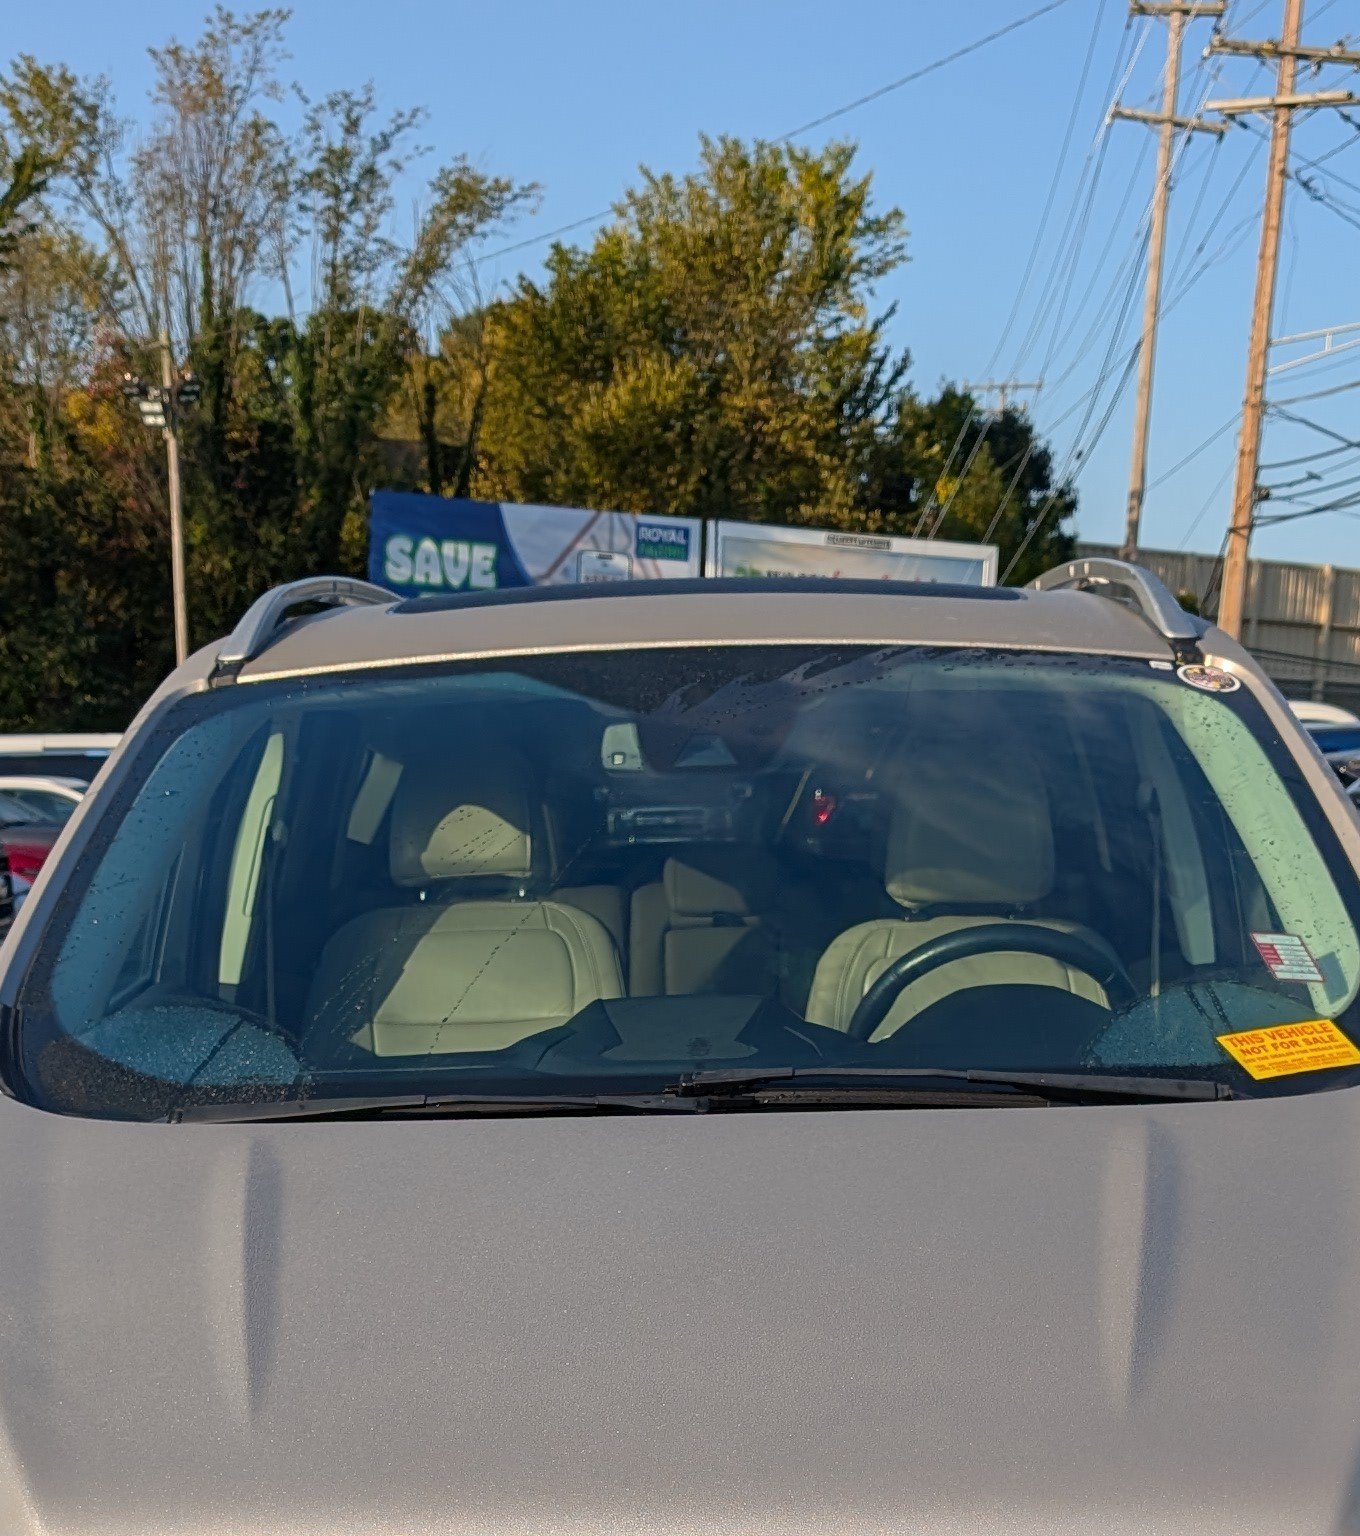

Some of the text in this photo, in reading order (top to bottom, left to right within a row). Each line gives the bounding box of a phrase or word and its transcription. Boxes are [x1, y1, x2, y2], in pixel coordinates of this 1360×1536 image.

[638, 526, 687, 545] ROYAL
[385, 535, 497, 588] SAVE
[1228, 1022, 1333, 1048] THIS VEHICLE
[1240, 1044, 1269, 1056] NOT
[1271, 1039, 1300, 1051] FOR
[1302, 1033, 1339, 1046] SALE
